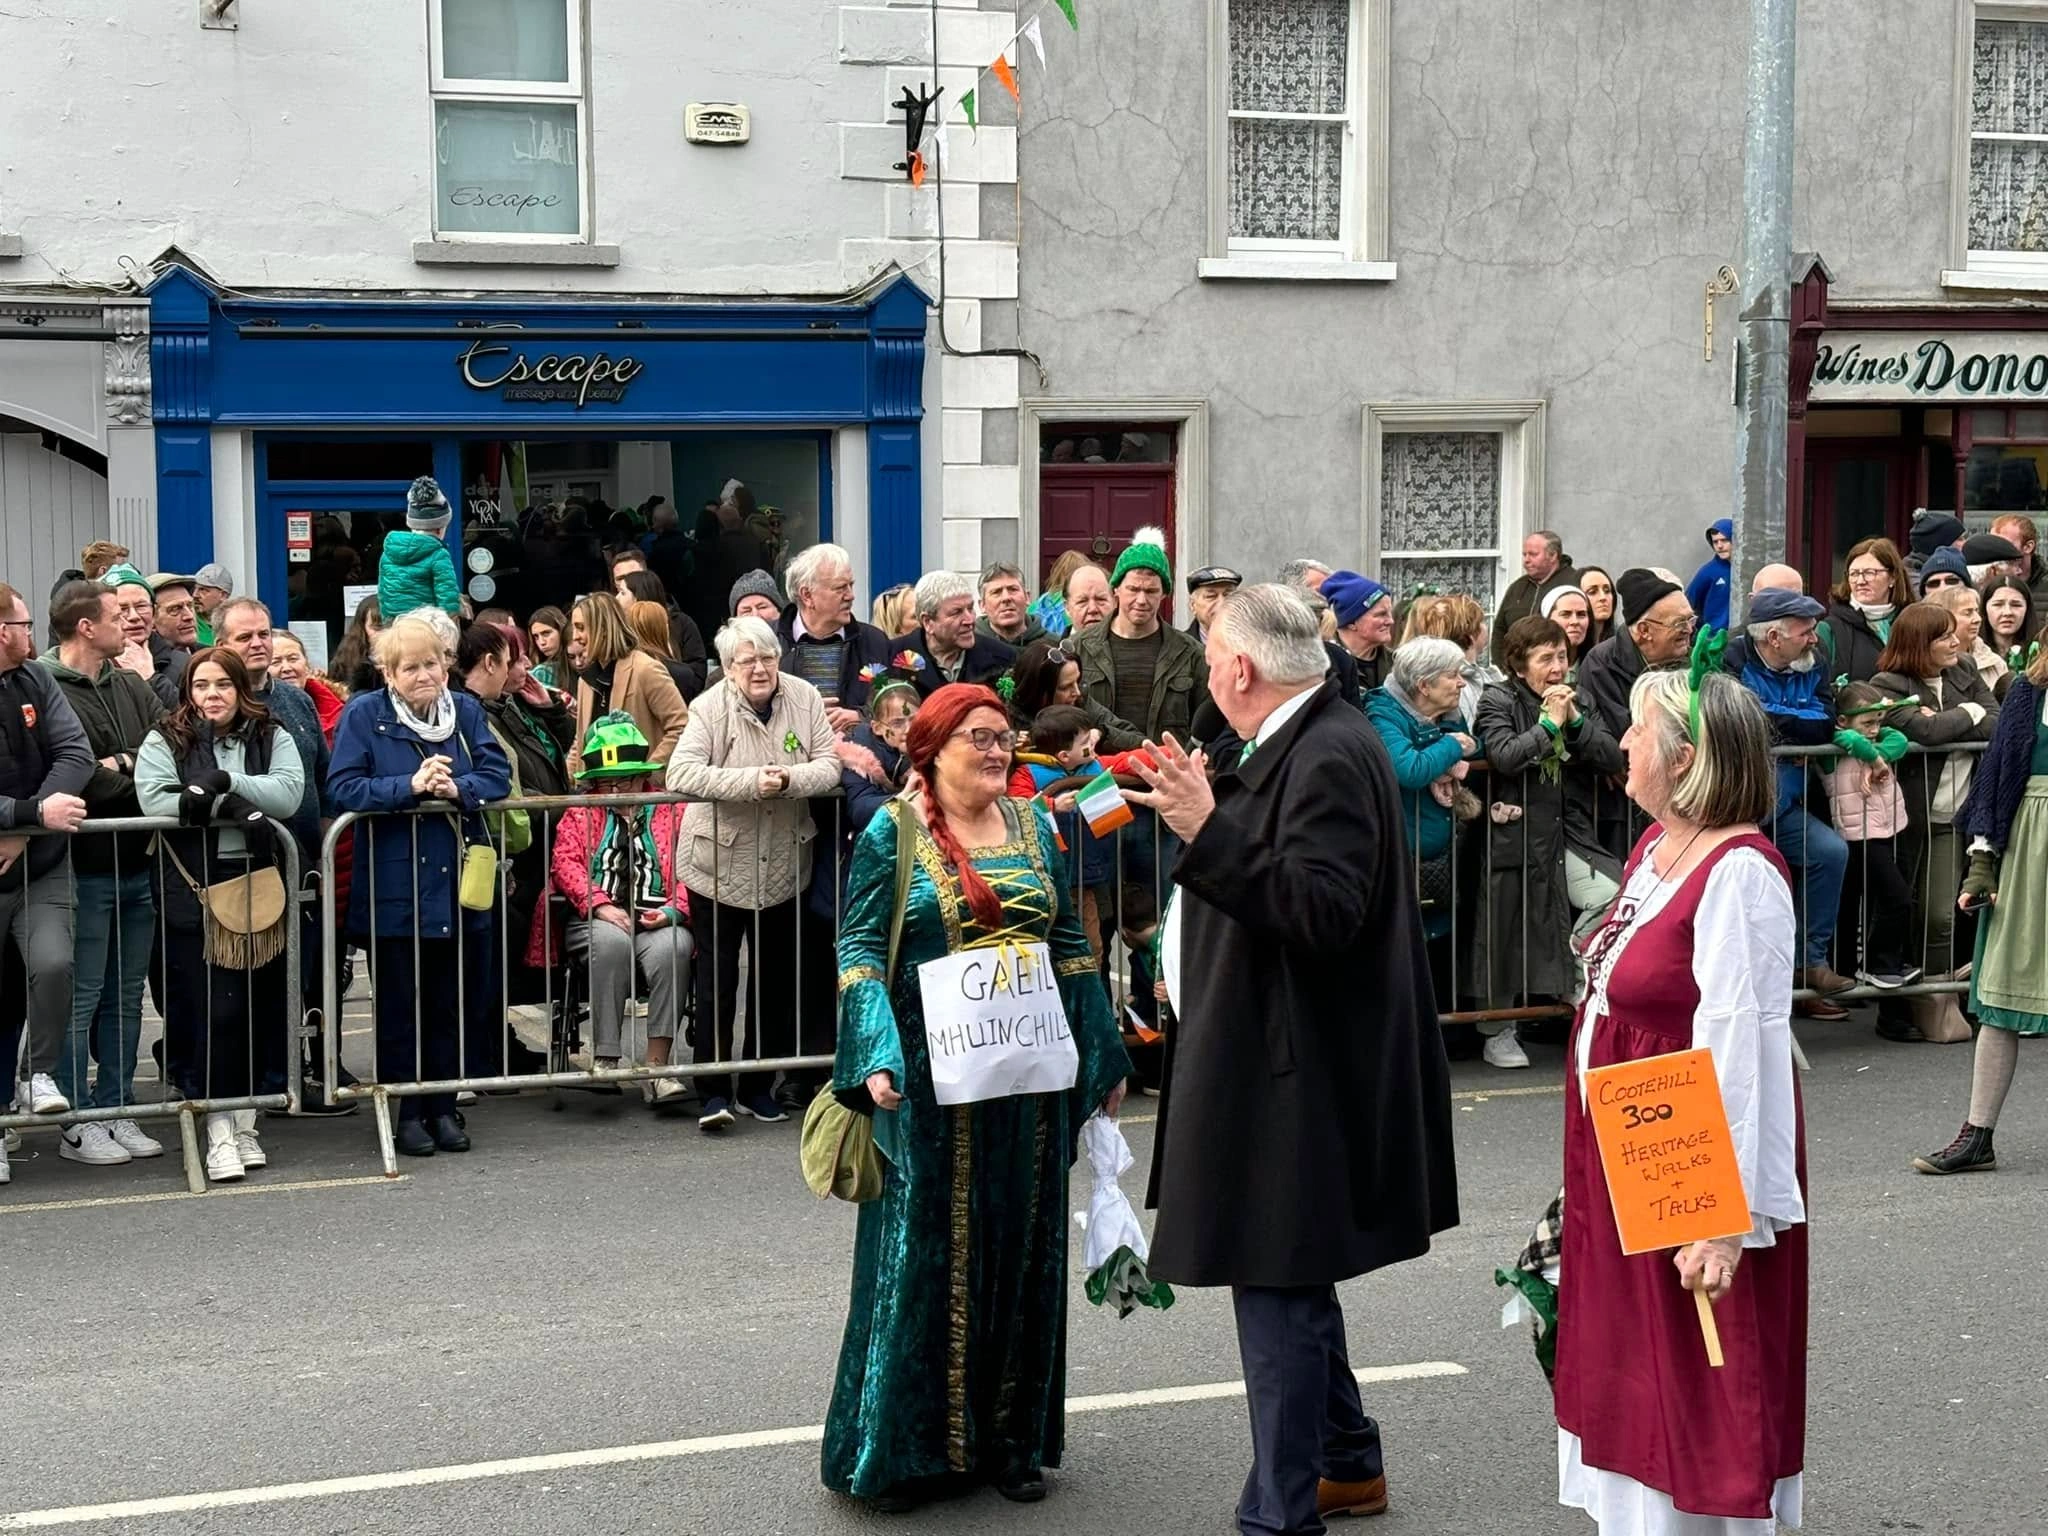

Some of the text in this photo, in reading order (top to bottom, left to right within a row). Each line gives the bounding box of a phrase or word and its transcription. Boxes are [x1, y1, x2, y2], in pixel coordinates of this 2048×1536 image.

[449, 187, 561, 216] Escape
[459, 323, 643, 406] Escape
[1815, 338, 2048, 394] Wines Dono
[961, 951, 1054, 1001] GAEIL
[1621, 1103, 1673, 1130] 300
[1621, 1130, 1713, 1165] HERITAGE
[1641, 1153, 1712, 1182] WALKS
